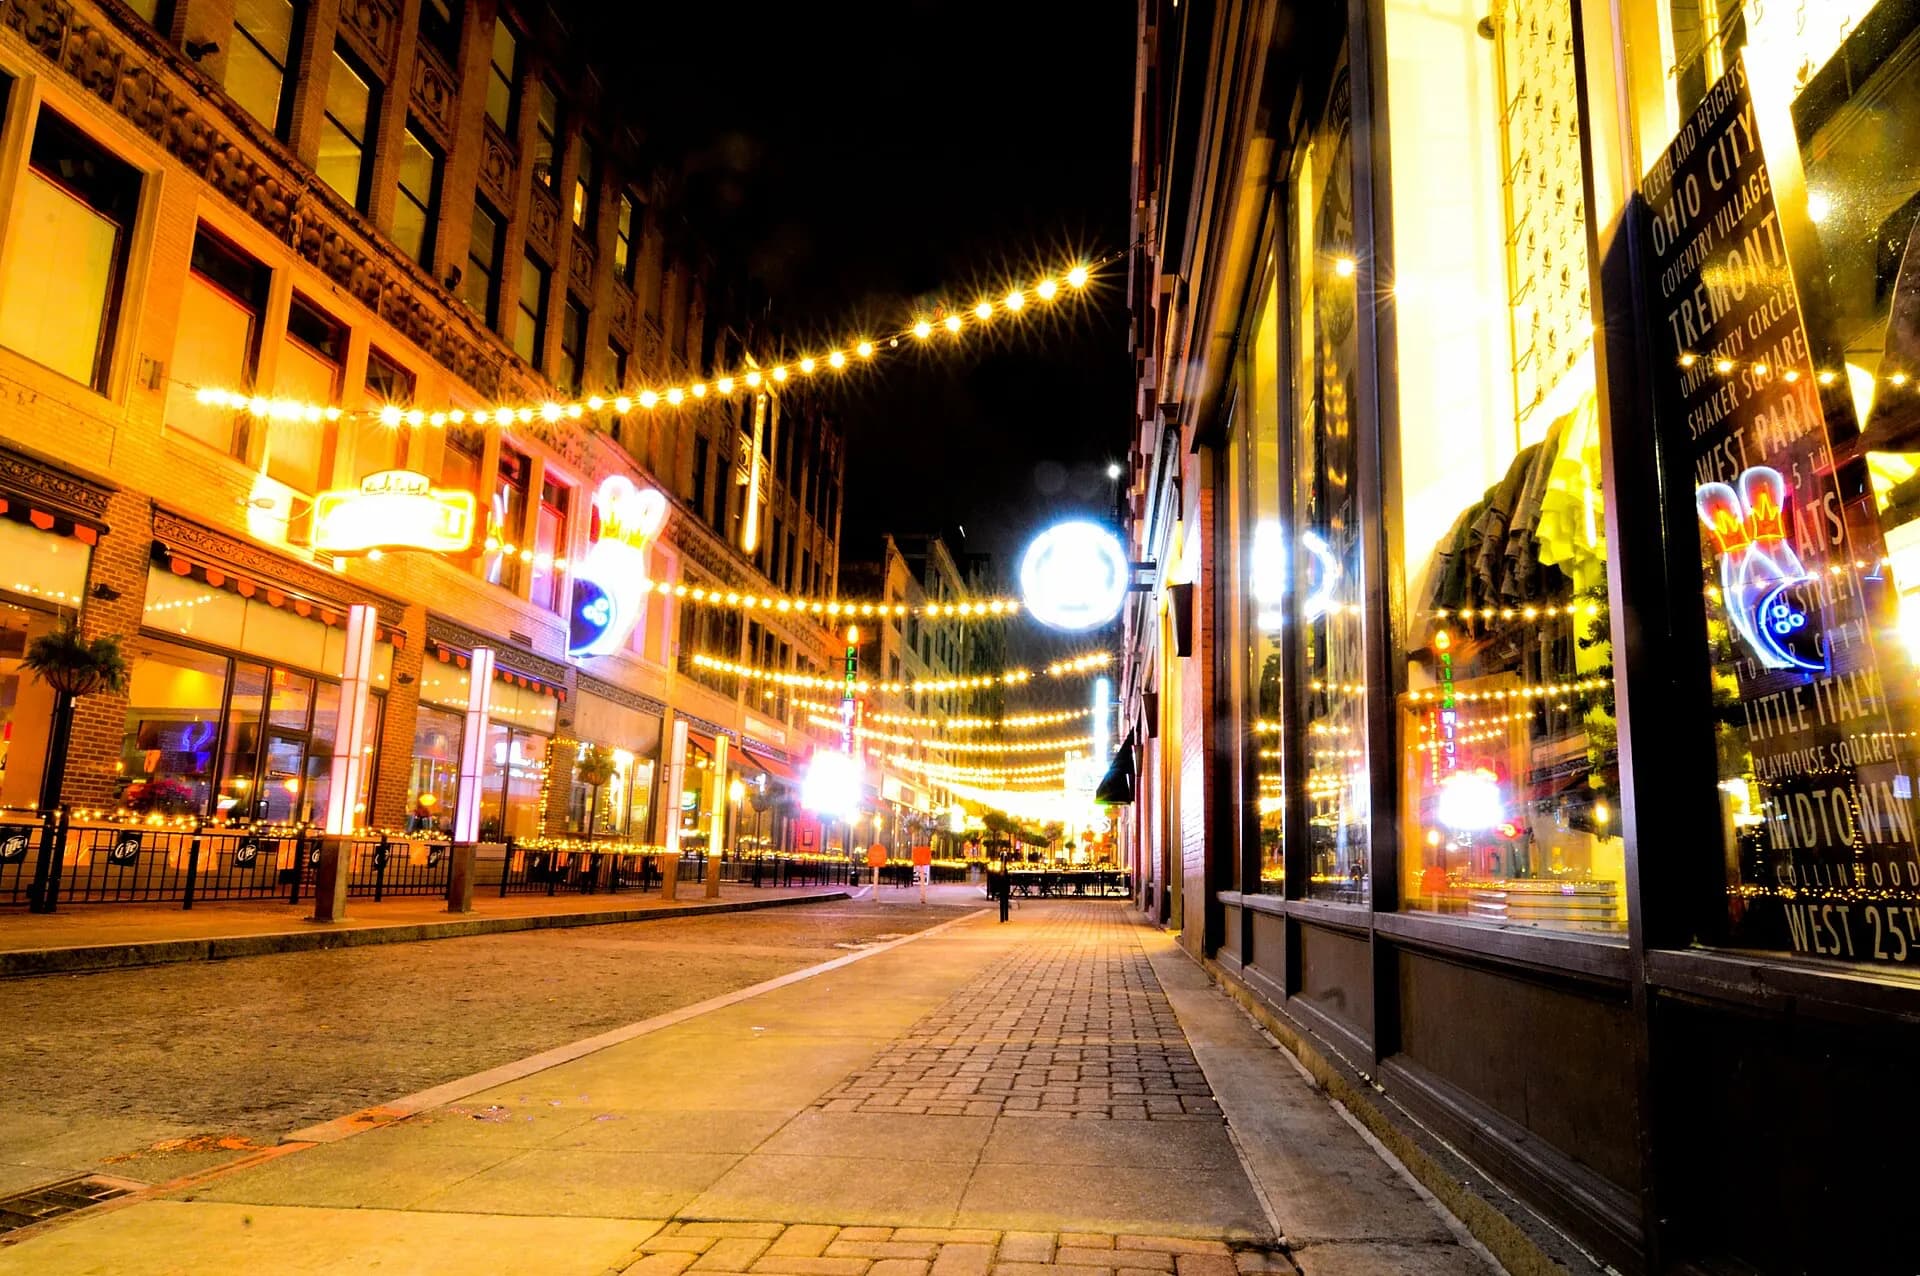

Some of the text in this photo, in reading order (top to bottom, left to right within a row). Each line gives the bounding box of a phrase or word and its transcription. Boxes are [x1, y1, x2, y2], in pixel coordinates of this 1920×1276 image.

[1643, 58, 1745, 205] CLEVELAND HEIGHTS
[1652, 101, 1755, 257] OHIO CITY
[1661, 164, 1770, 298] COVENTRY VILLAGE
[1669, 210, 1780, 356] TREMONT
[1680, 282, 1795, 399] UNIVERSITY CIRCLE
[1688, 326, 1805, 441] SHAKER SQUARE
[1695, 379, 1820, 496] WEST PARK
[1795, 565, 1855, 616] STREET
[1736, 616, 1866, 683] TOR CITY
[1743, 665, 1879, 742] LITTLE ITALY
[1755, 734, 1895, 781] PLAYHOUSE SQUARE
[1765, 782, 1911, 849] MIDTOWN
[1776, 861, 1919, 888] COLLINWOOD
[1784, 903, 1854, 957] WEST
